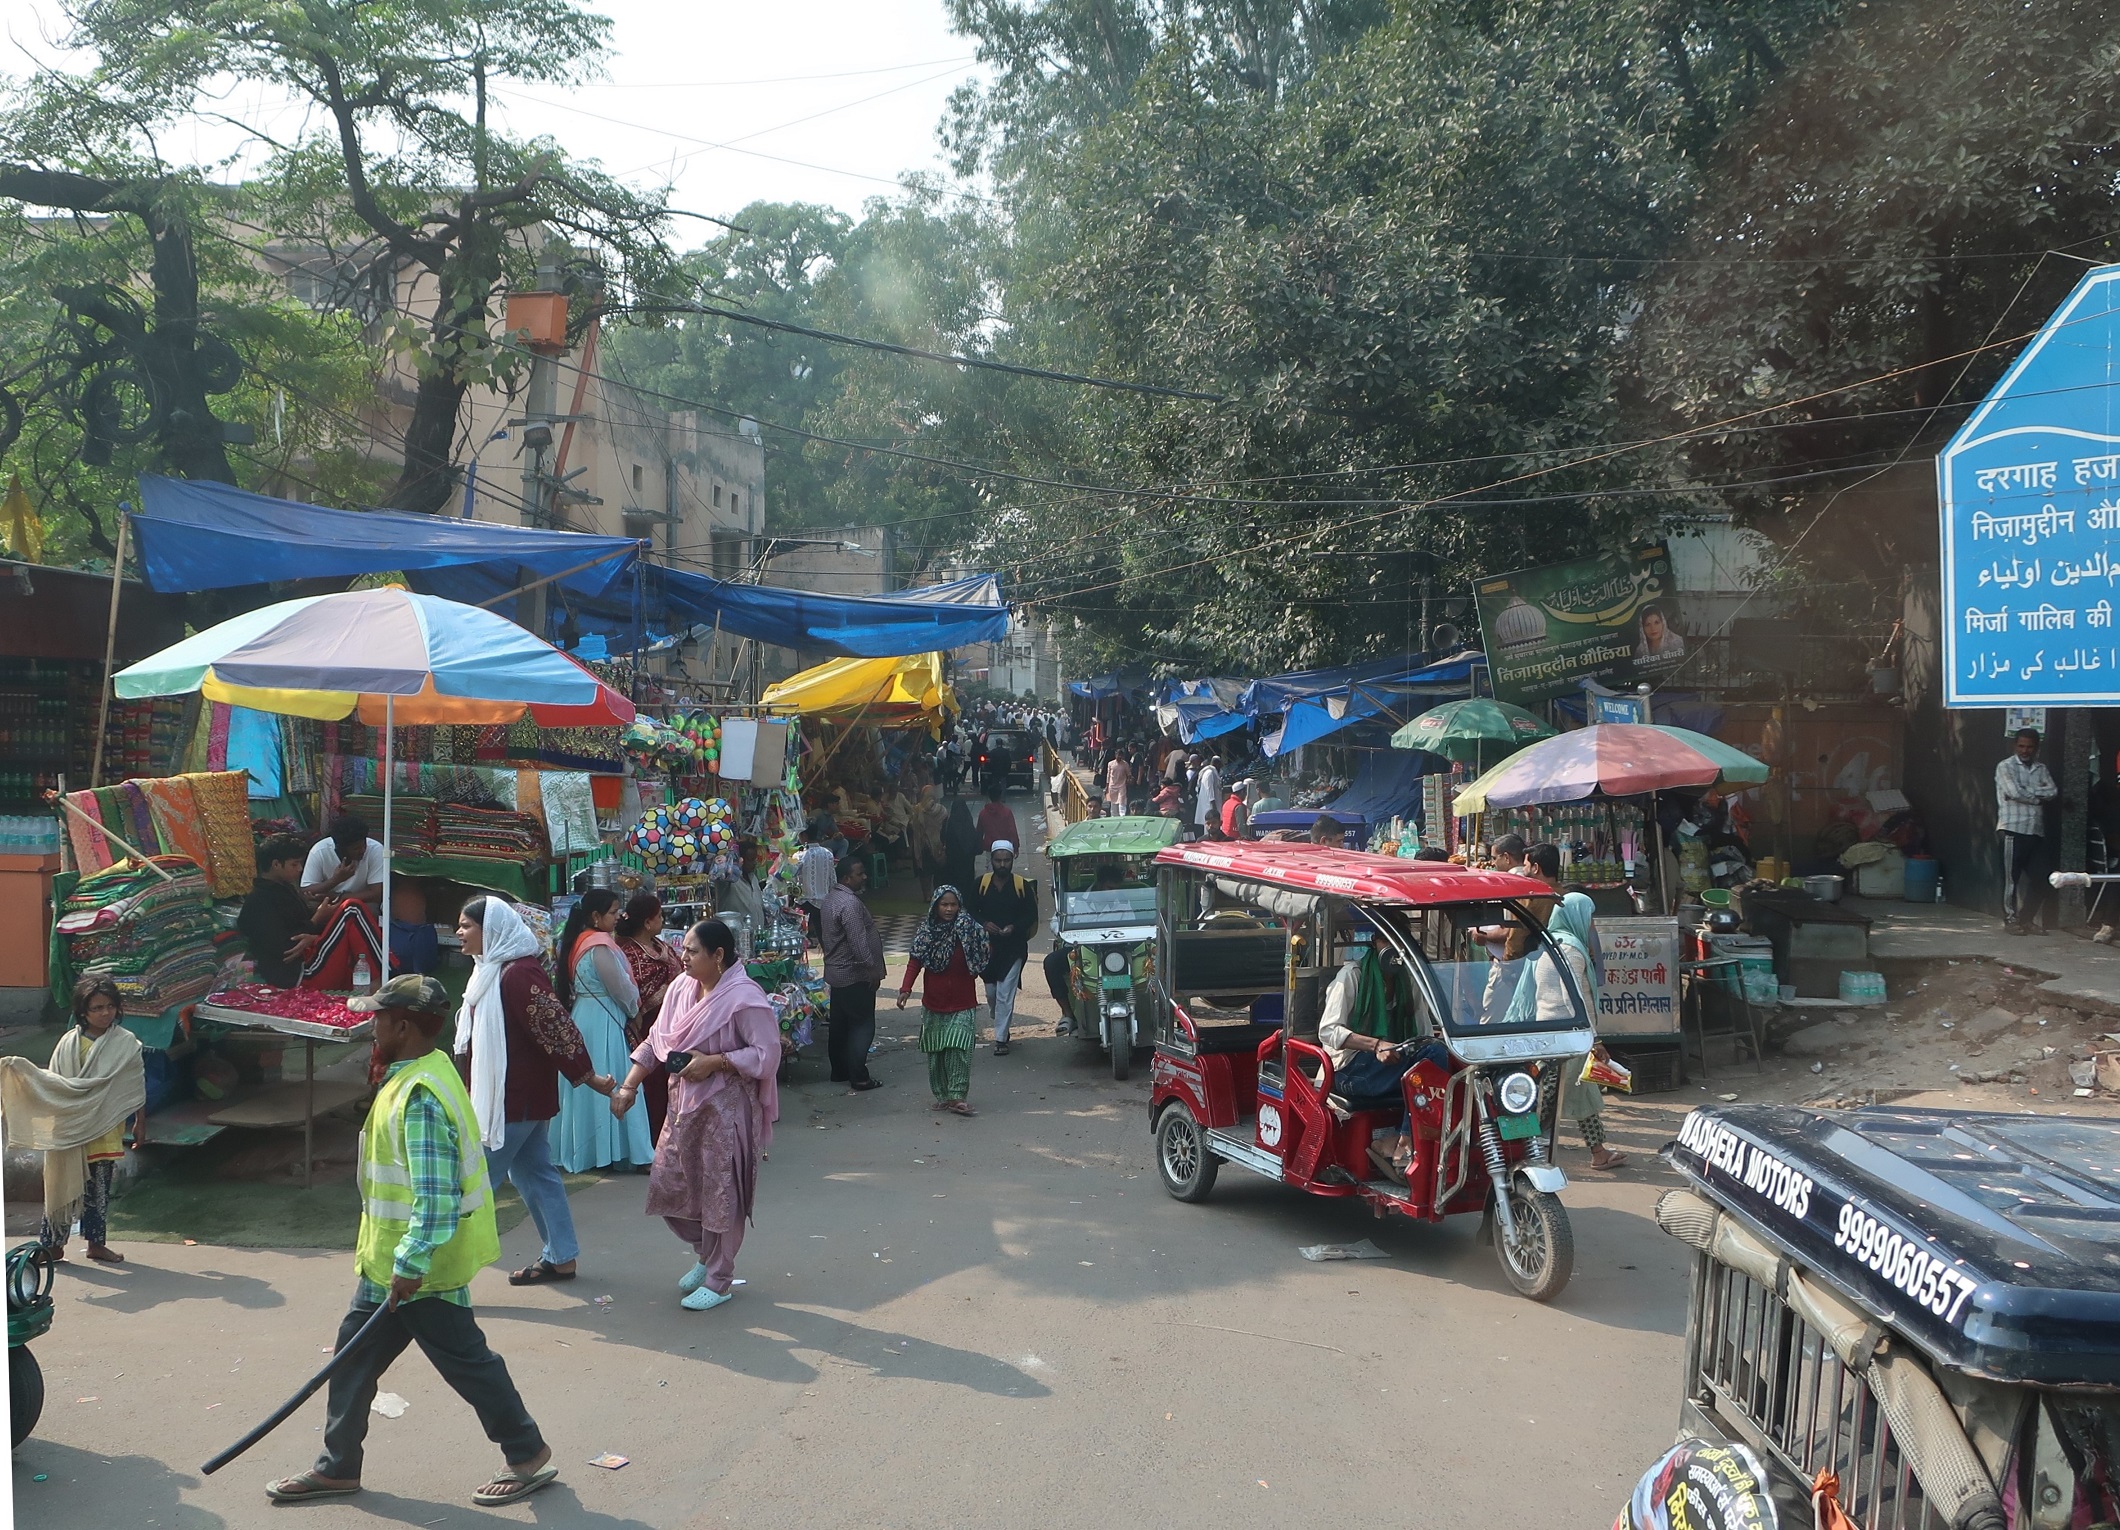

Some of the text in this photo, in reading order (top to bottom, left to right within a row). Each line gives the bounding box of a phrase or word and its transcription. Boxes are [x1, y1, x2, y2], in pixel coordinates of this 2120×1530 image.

[1975, 453, 2120, 493] दरगाह हज
[2018, 603, 2076, 632] गालिब
[2085, 599, 2113, 630] की
[1579, 643, 1632, 668] औलिया
[1603, 701, 1629, 716] WELCOME
[1640, 962, 1667, 985] पानी
[1615, 991, 1637, 1015] प्रति
[1744, 1147, 1813, 1220] MOTORS
[1833, 1203, 1978, 1324] 9999060557
